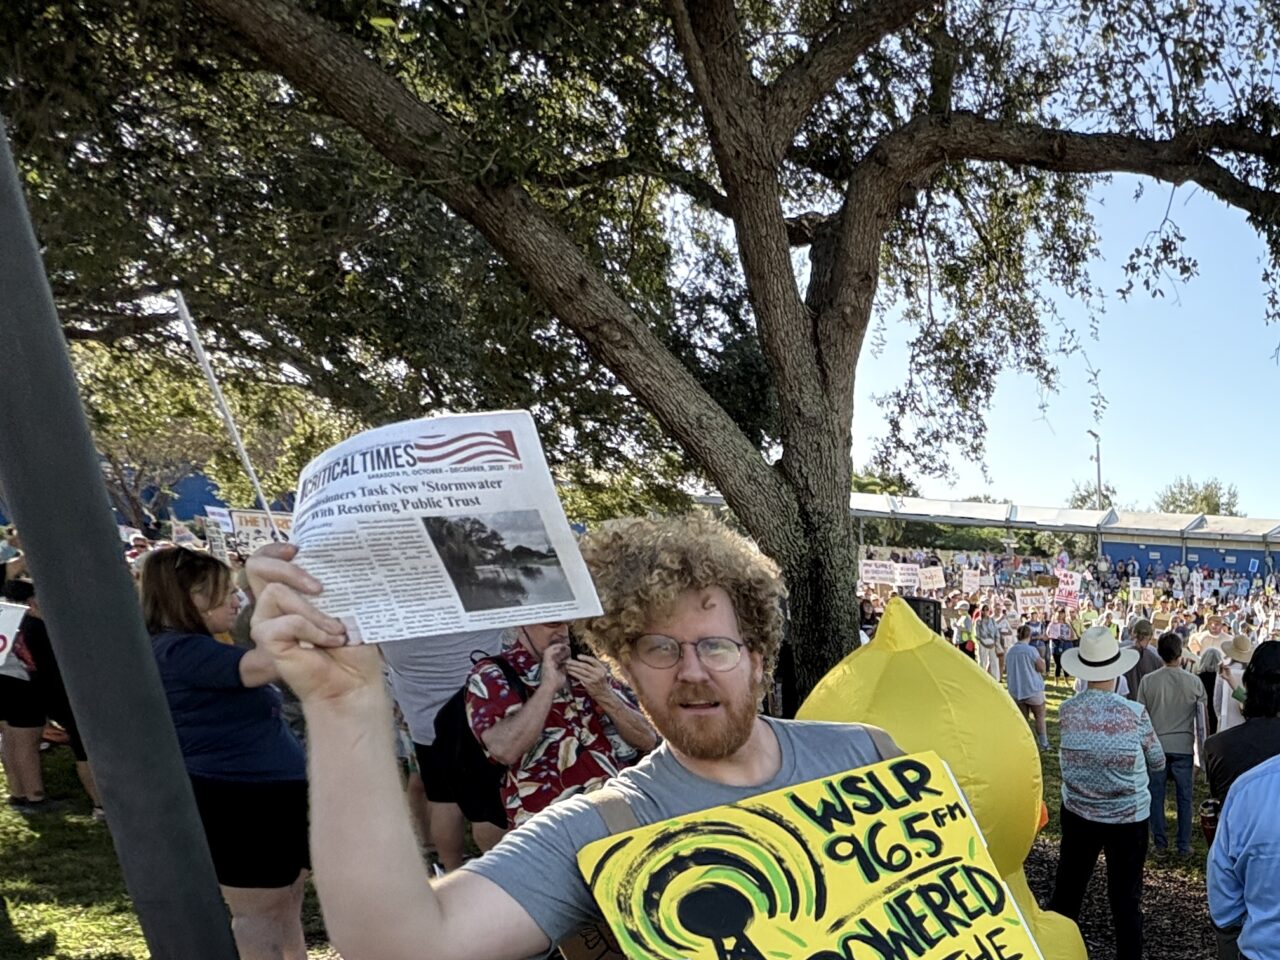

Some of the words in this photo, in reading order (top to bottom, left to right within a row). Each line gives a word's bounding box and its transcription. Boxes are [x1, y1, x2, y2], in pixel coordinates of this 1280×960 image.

[359, 443, 417, 473] TIMES
[412, 467, 442, 476] OCTOBER
[360, 484, 388, 498] Task
[390, 482, 418, 496] New
[421, 478, 503, 493] 'Stormwater
[311, 507, 334, 520] With
[337, 500, 400, 515] Restoring
[401, 497, 443, 512] Public
[444, 495, 481, 508] Trust
[788, 757, 945, 834] WSLR
[826, 810, 944, 885] 96.5
[931, 802, 968, 829] FM
